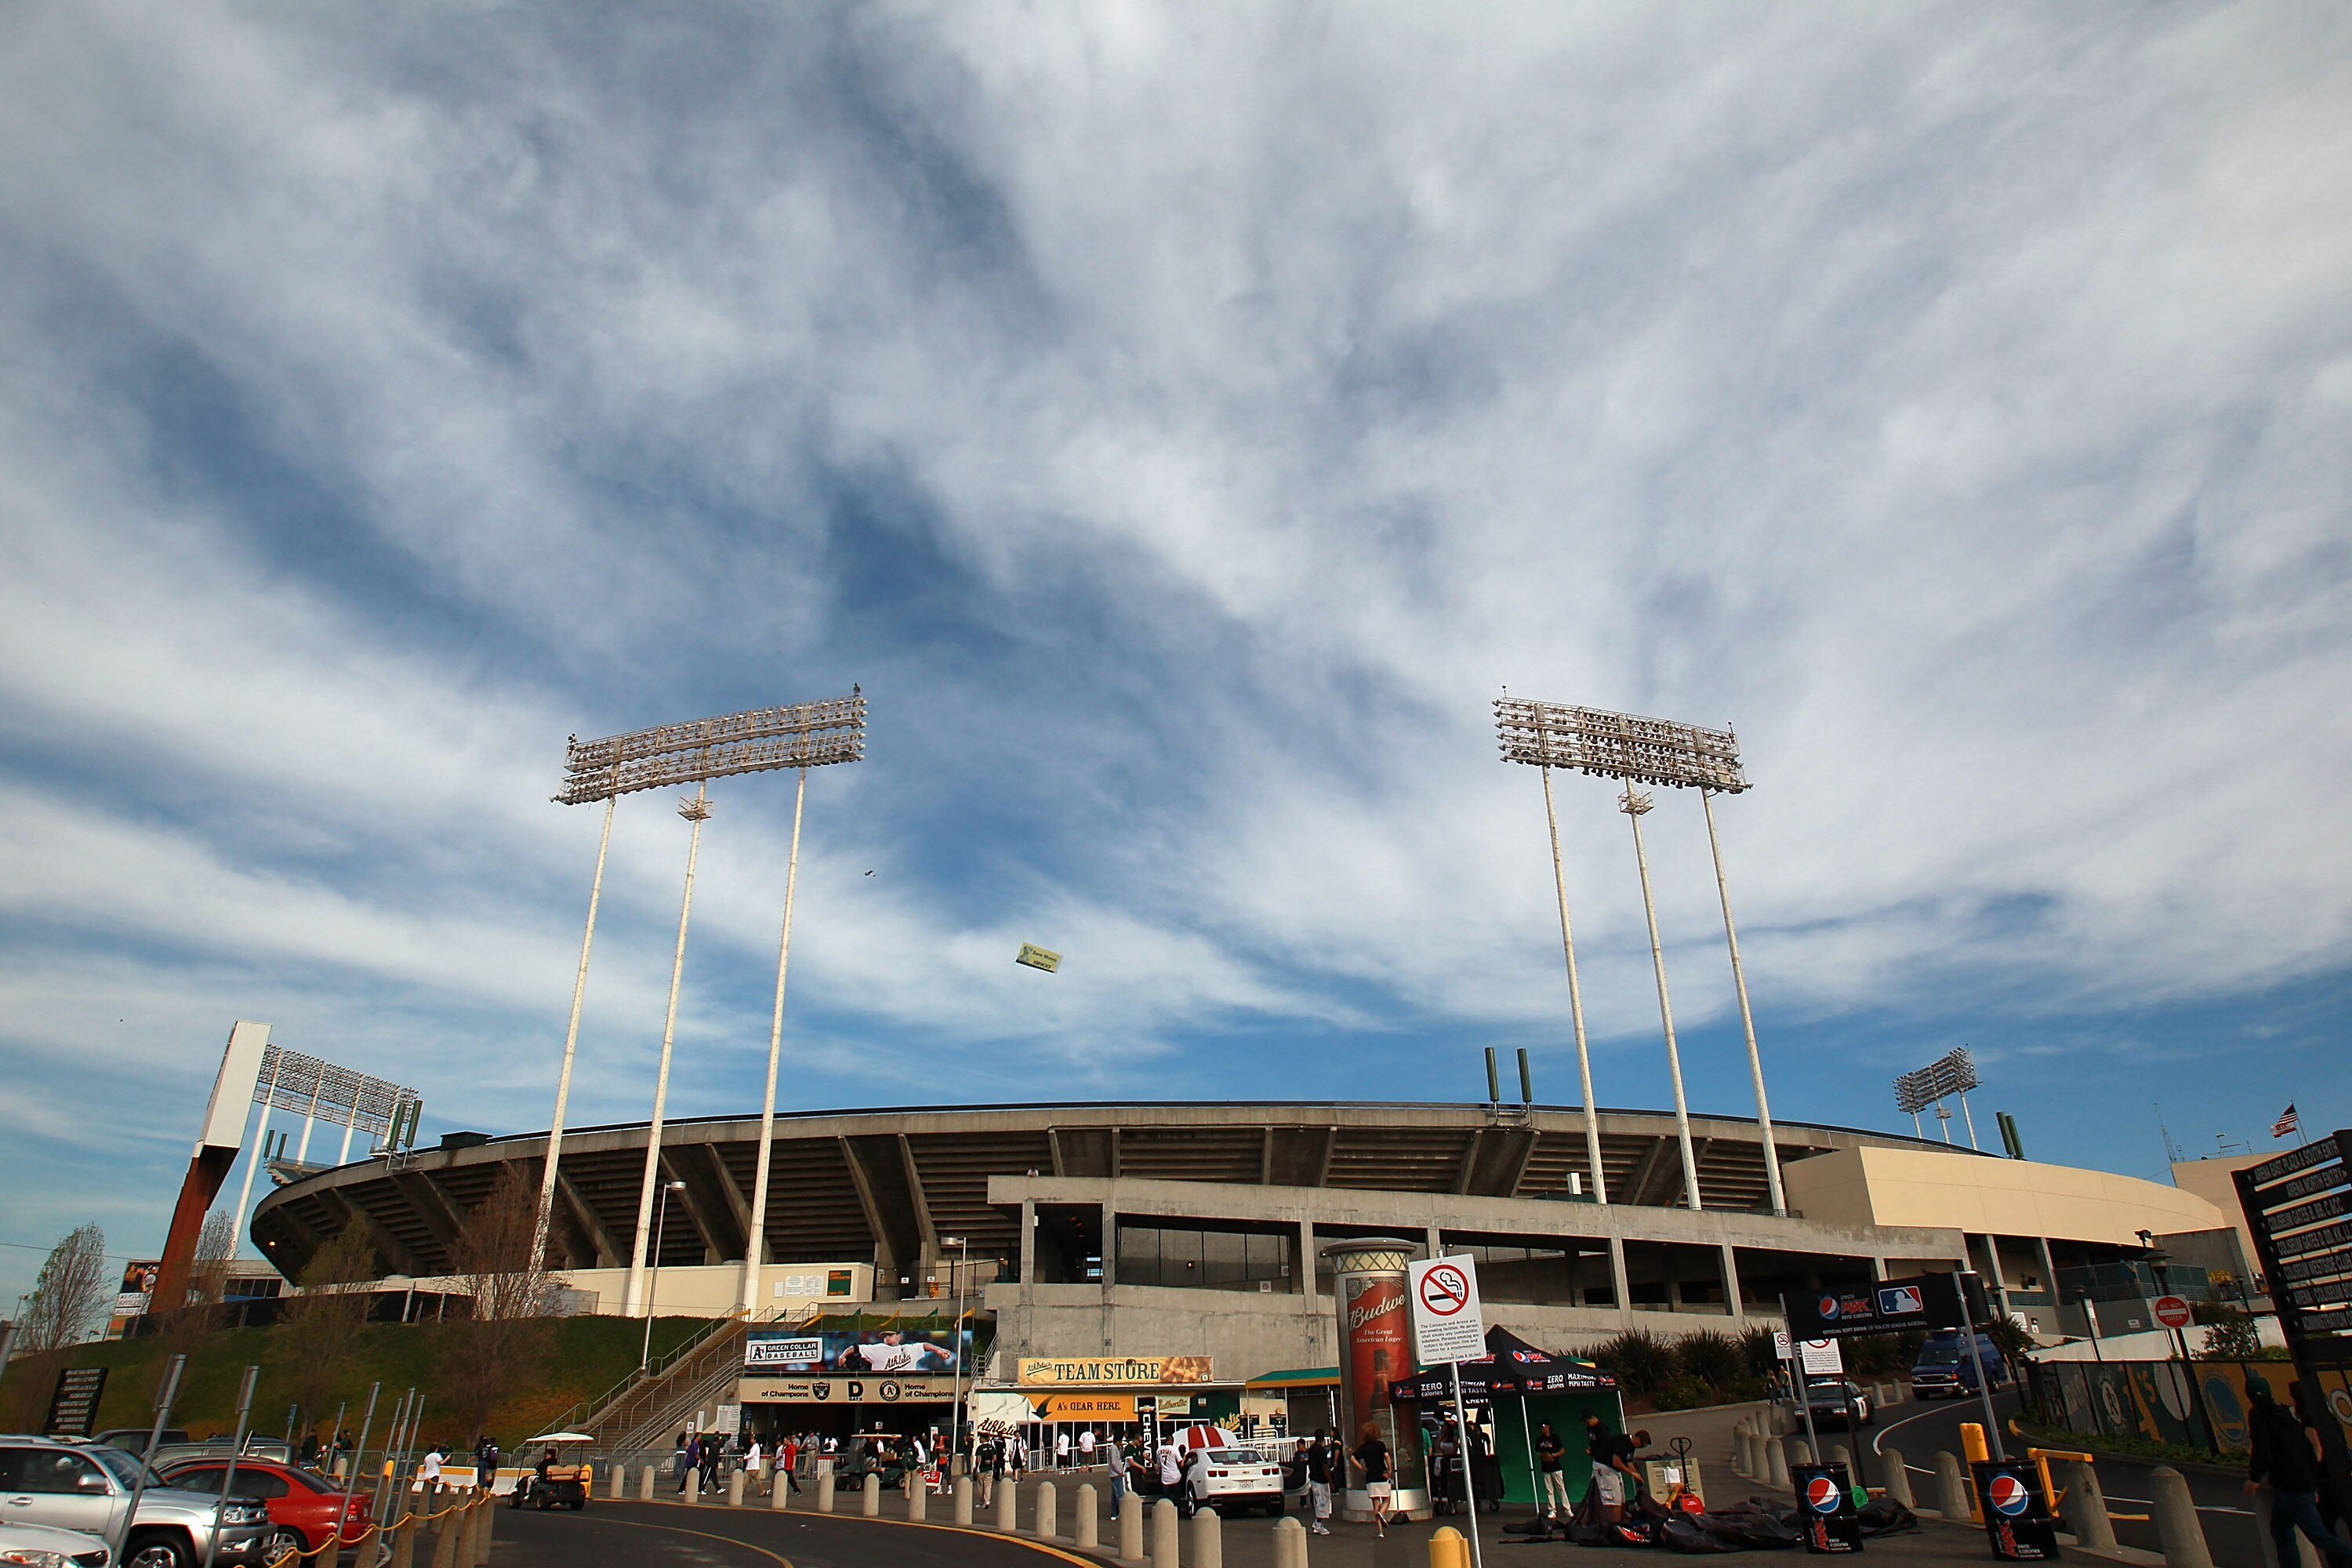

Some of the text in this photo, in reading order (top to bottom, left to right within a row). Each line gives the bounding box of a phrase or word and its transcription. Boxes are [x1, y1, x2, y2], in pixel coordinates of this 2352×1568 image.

[1054, 1363, 1160, 1380] TEAM STORE
[1548, 1374, 1563, 1384] ZERO
[848, 1381, 863, 1397] D
[1421, 1382, 1443, 1391] ZERO
[1097, 1402, 1121, 1410] HERE.
[1162, 1455, 1167, 1465] 7
